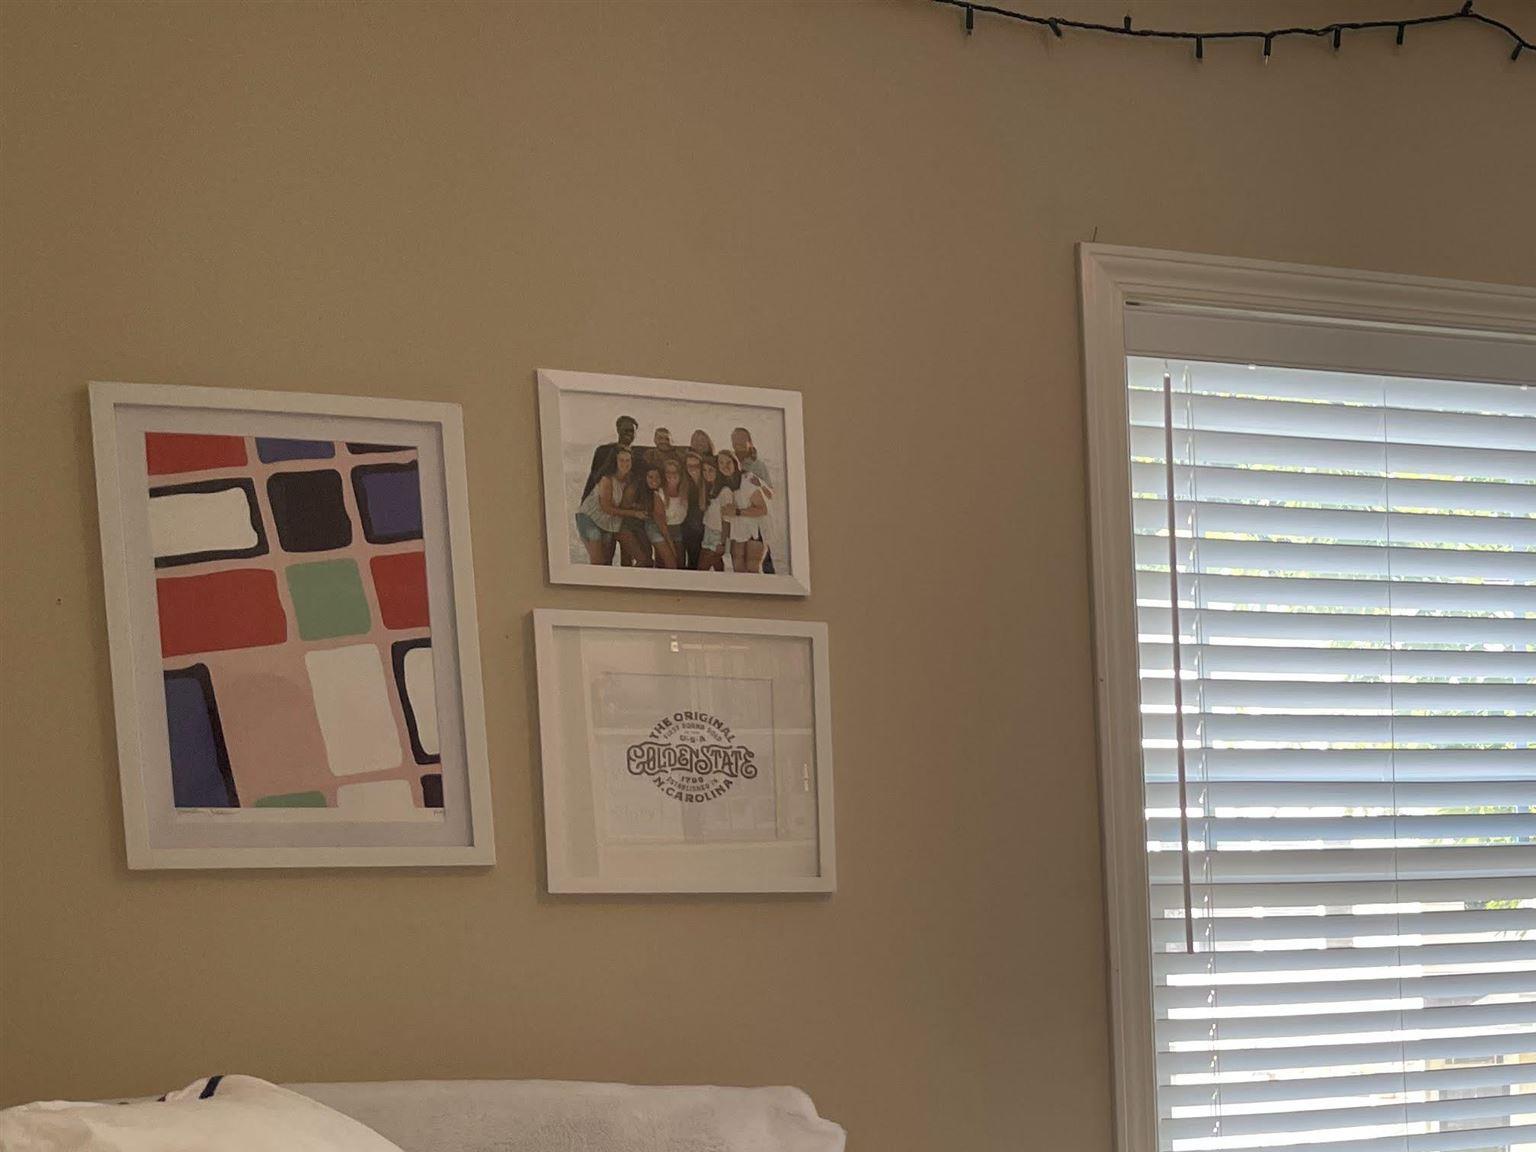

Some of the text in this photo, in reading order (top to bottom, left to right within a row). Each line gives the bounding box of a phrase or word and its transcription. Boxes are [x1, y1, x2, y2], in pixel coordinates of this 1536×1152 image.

[649, 711, 736, 743] THE ORIGINAL
[666, 778, 733, 803] CAROLINA
